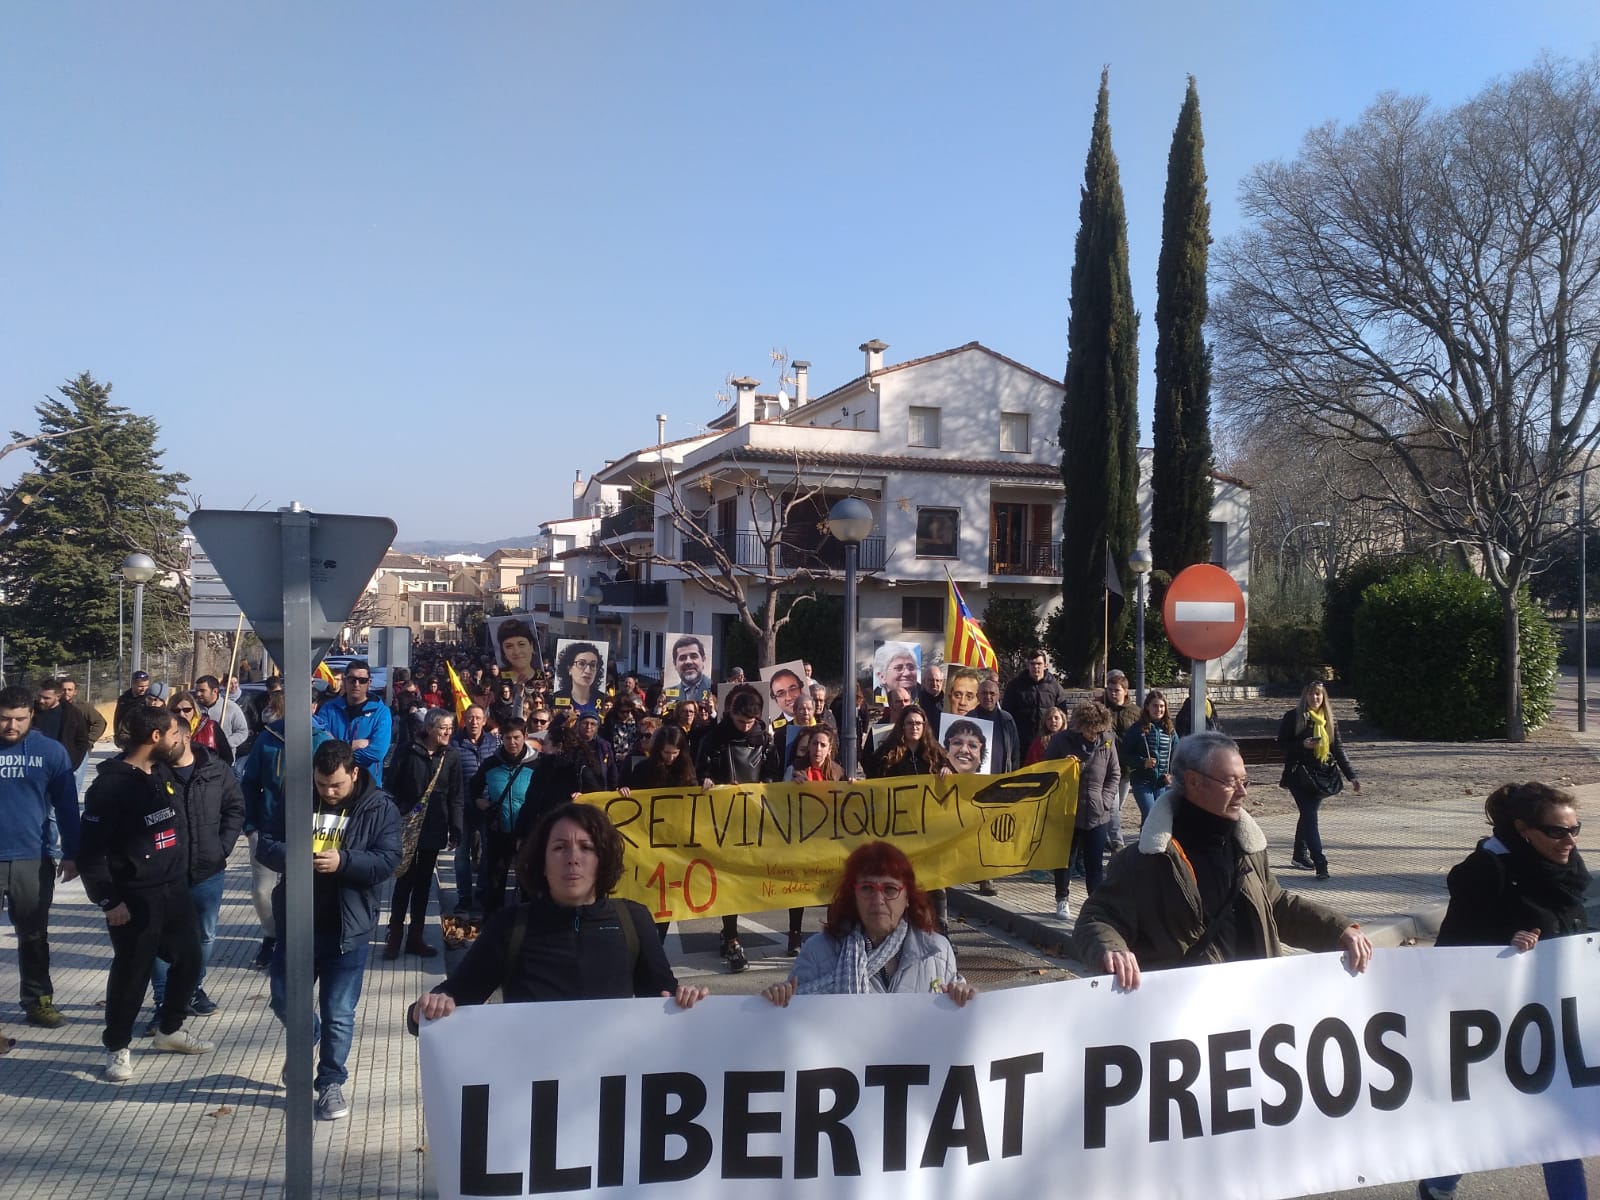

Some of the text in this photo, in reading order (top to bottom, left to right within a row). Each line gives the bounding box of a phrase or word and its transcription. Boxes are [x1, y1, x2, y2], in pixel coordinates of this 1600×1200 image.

[604, 783, 964, 849] REIVINDIQUEM
[460, 1052, 1044, 1196] LLIBERTAT
[1084, 1011, 1413, 1149] PRESOS
